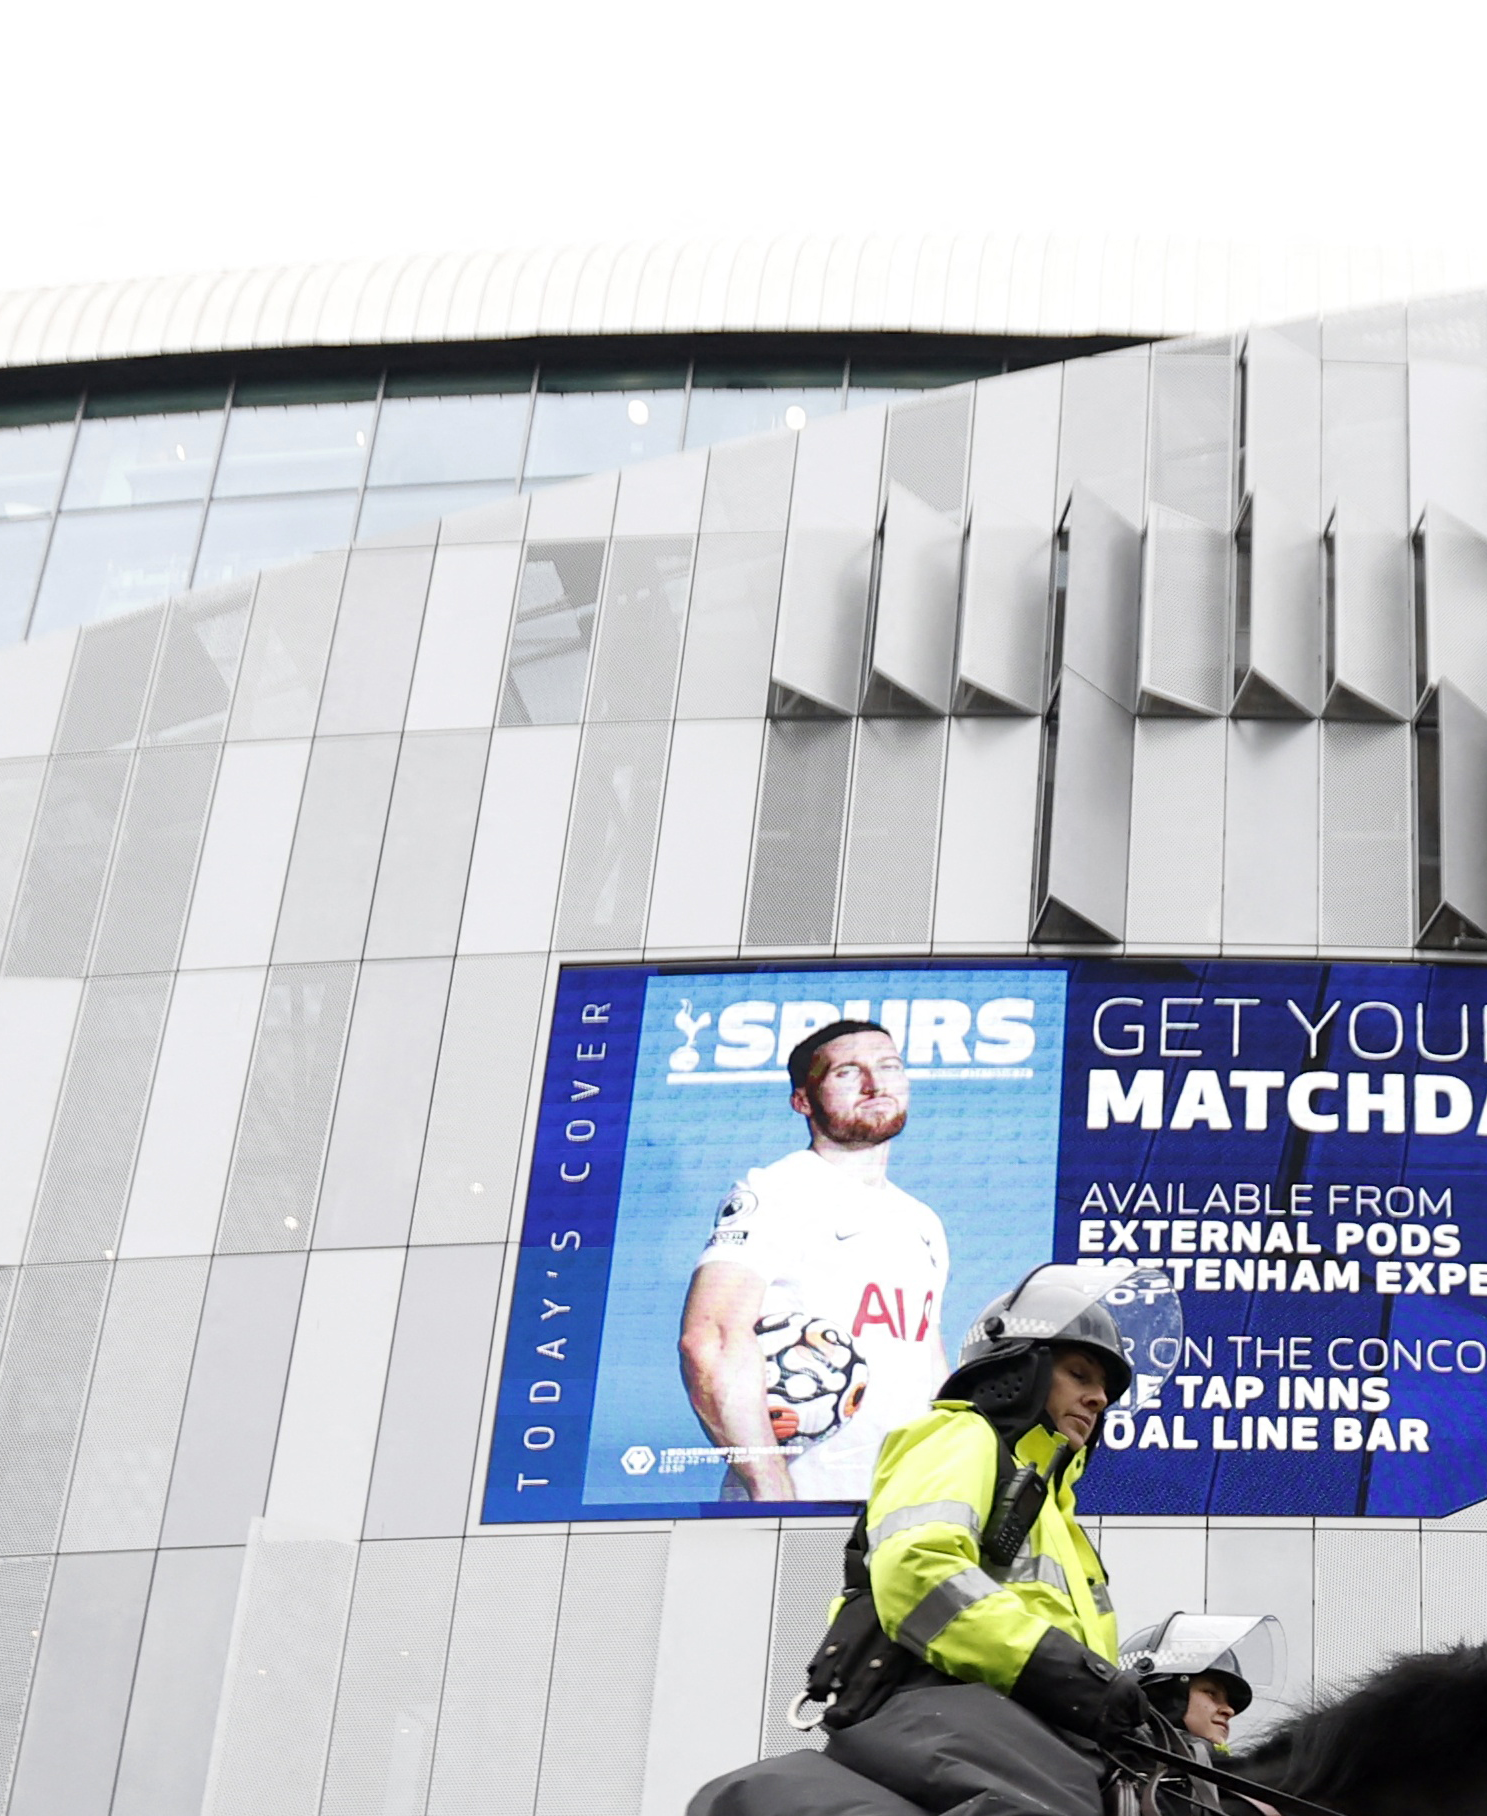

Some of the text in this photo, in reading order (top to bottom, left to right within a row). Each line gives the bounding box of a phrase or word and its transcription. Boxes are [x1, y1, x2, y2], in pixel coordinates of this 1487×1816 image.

[714, 998, 1035, 1068] SPURS
[1093, 998, 1261, 1057] GET
[1079, 1182, 1453, 1218] AVAILABLE FROM
[517, 1001, 612, 1493] TODAY'S COVER
[1078, 1219, 1461, 1257] EXTERNAL PODS
[1076, 1257, 1360, 1294] TENHAM
[1149, 1335, 1213, 1370] ON
[1227, 1335, 1313, 1370] THE
[1175, 1375, 1265, 1410] TAP
[1278, 1376, 1391, 1412] INNS
[1096, 1414, 1430, 1453] OAL LINE BAR
